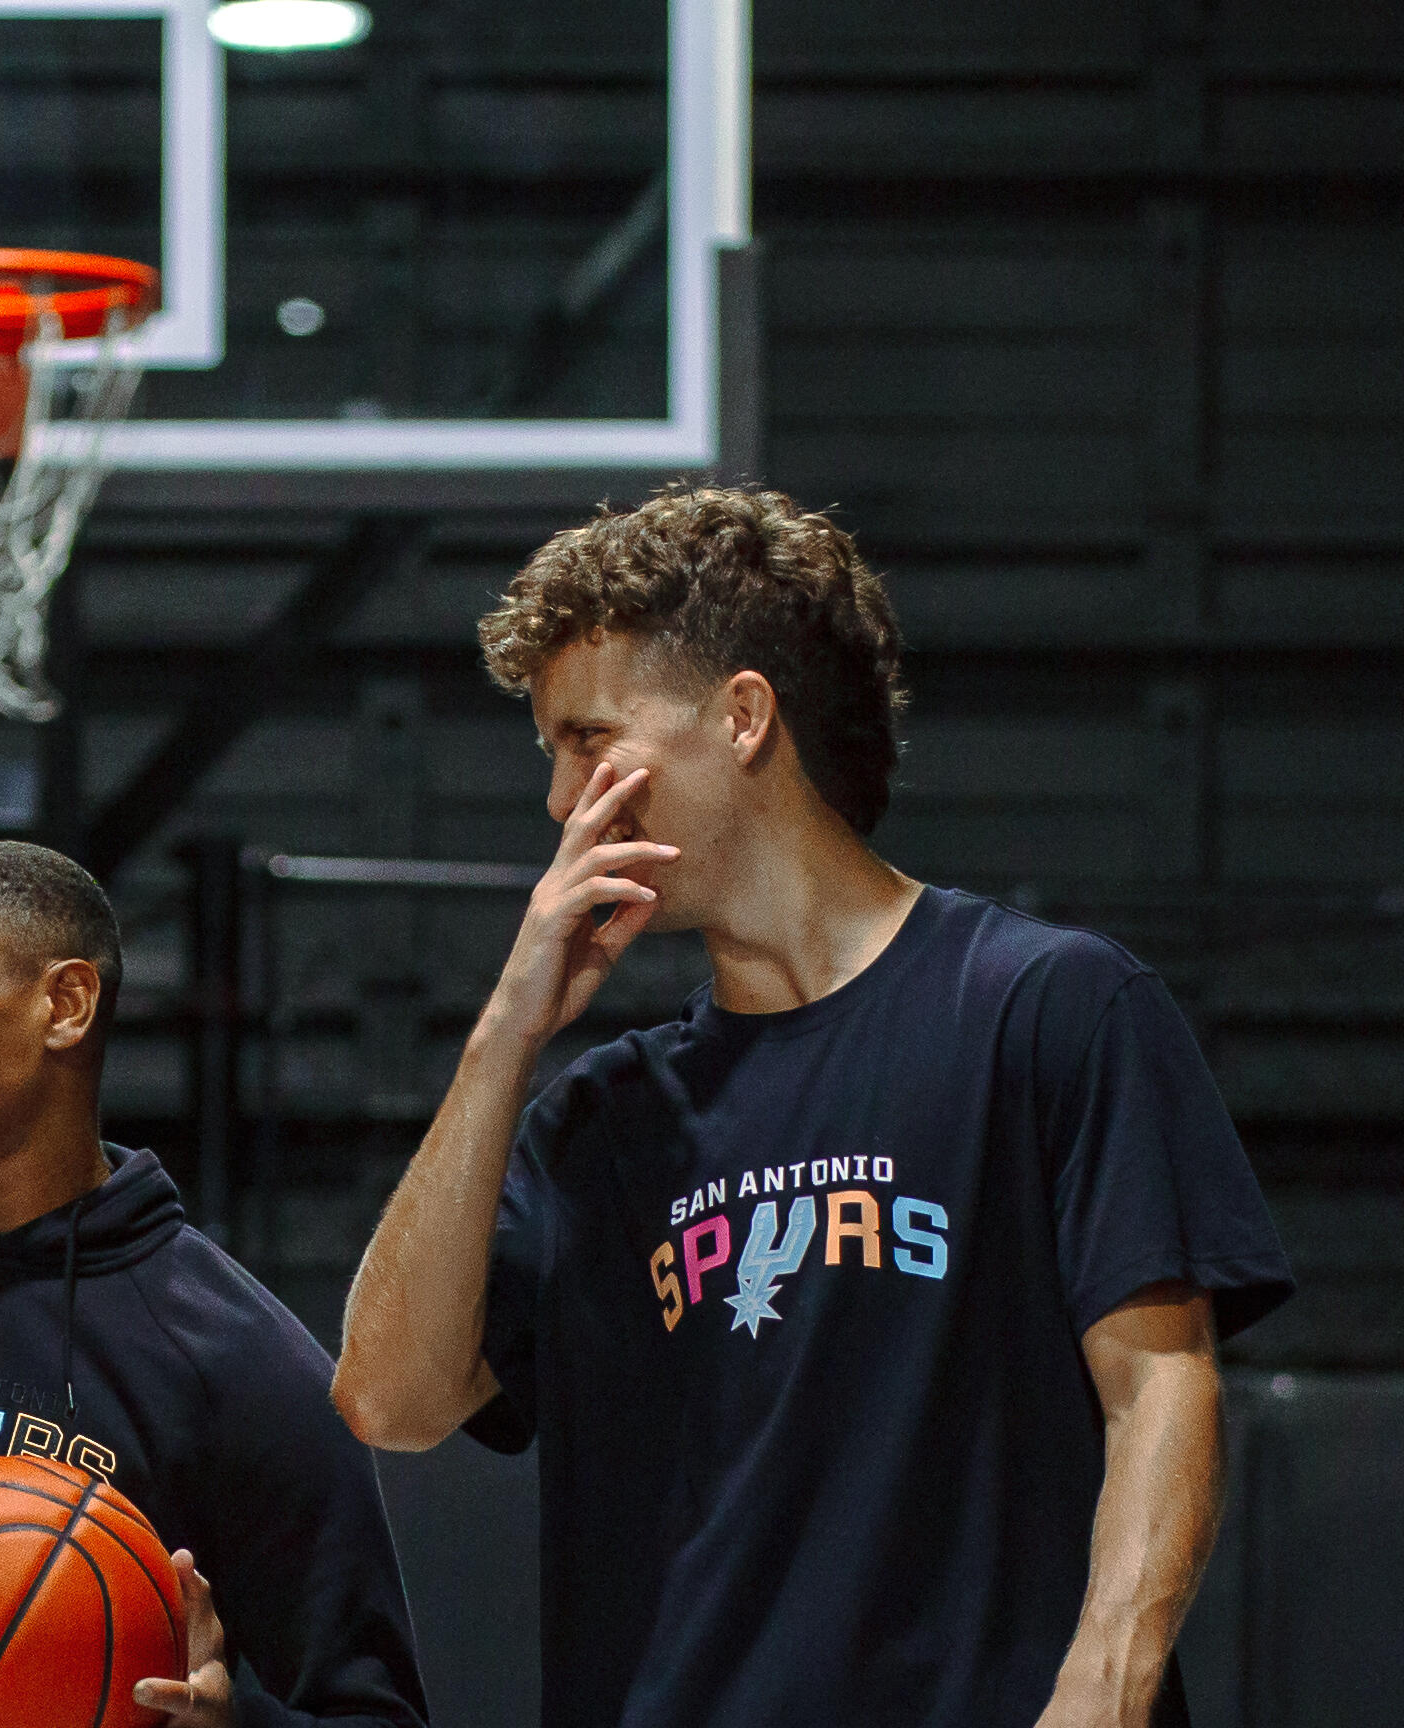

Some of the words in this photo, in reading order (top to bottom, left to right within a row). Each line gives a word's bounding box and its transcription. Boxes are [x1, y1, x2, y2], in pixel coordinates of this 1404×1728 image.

[670, 1178, 727, 1227] SAN
[738, 1154, 894, 1199] ANTONIO
[649, 1189, 949, 1341] SPURS
